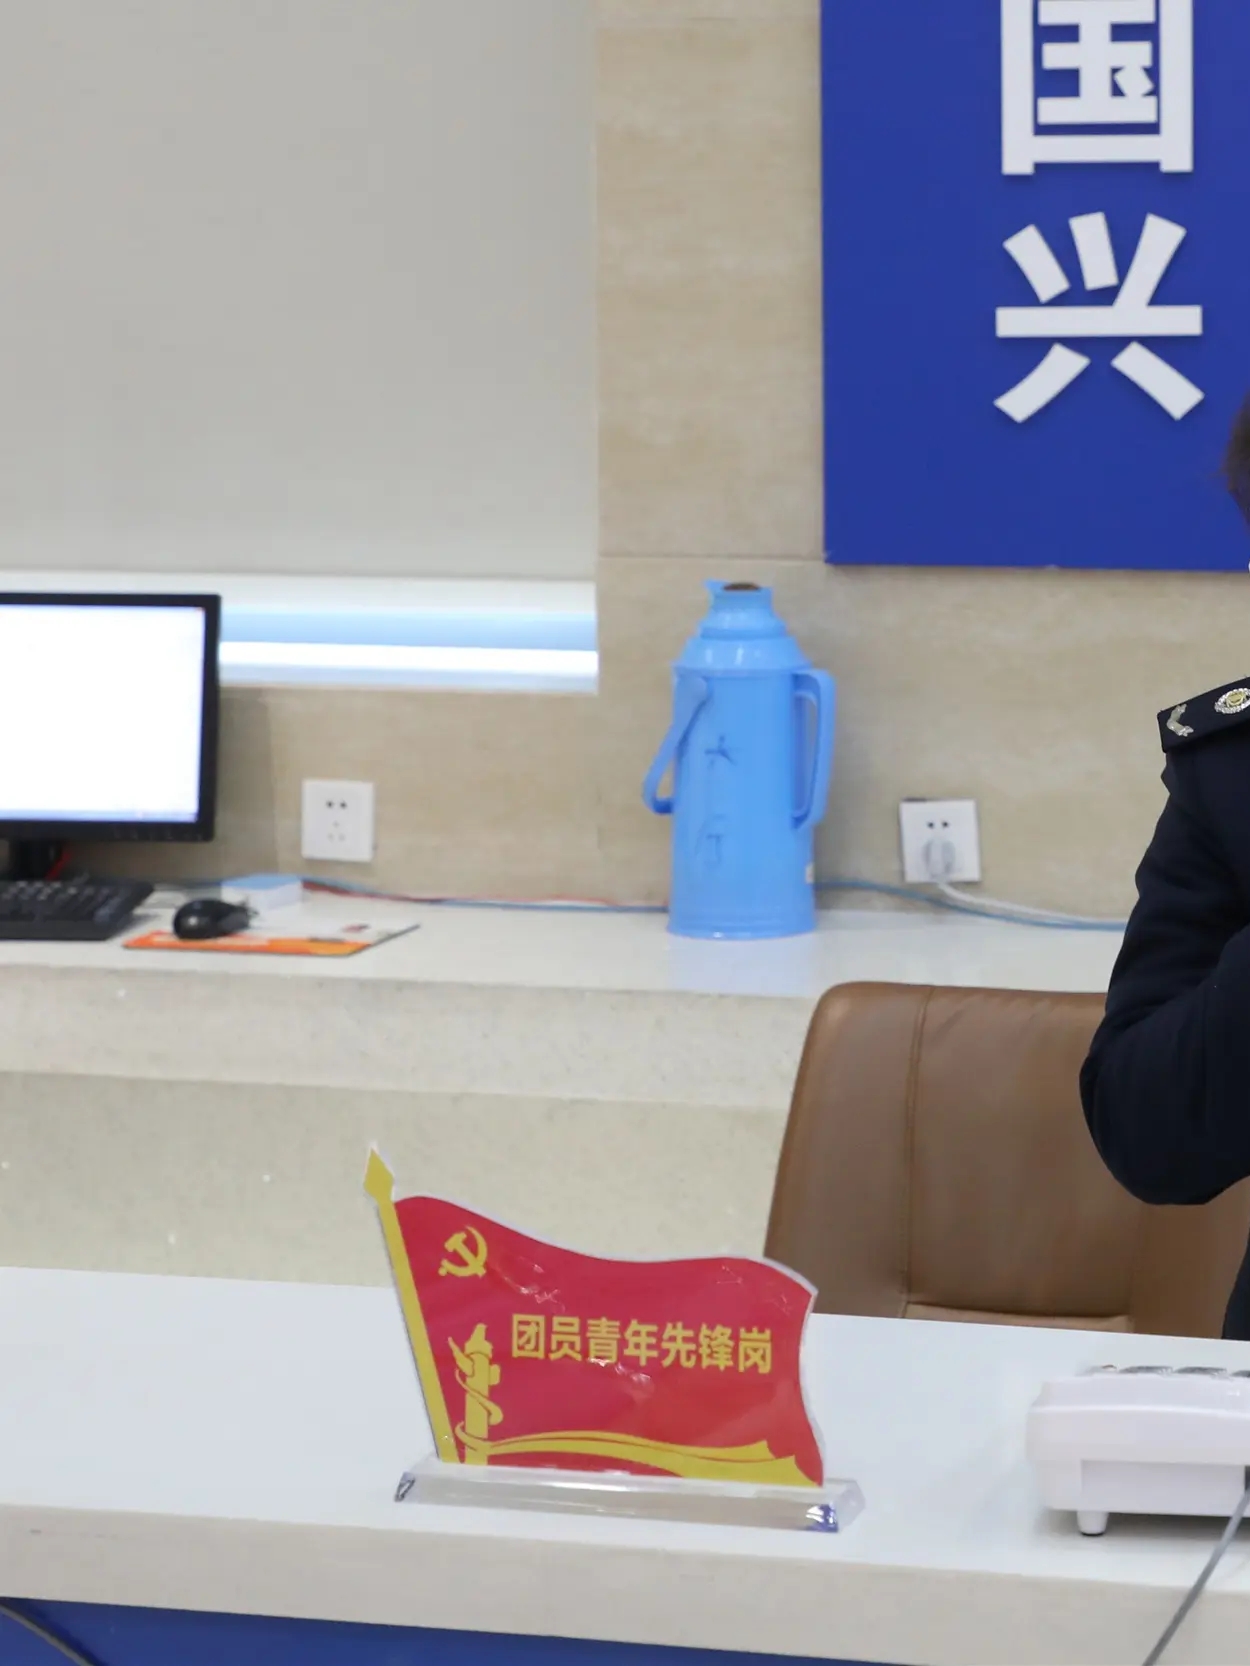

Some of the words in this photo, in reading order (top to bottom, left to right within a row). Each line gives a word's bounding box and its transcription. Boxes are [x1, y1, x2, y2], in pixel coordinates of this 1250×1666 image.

[512, 1314, 772, 1374] 团员青年先锋岗
